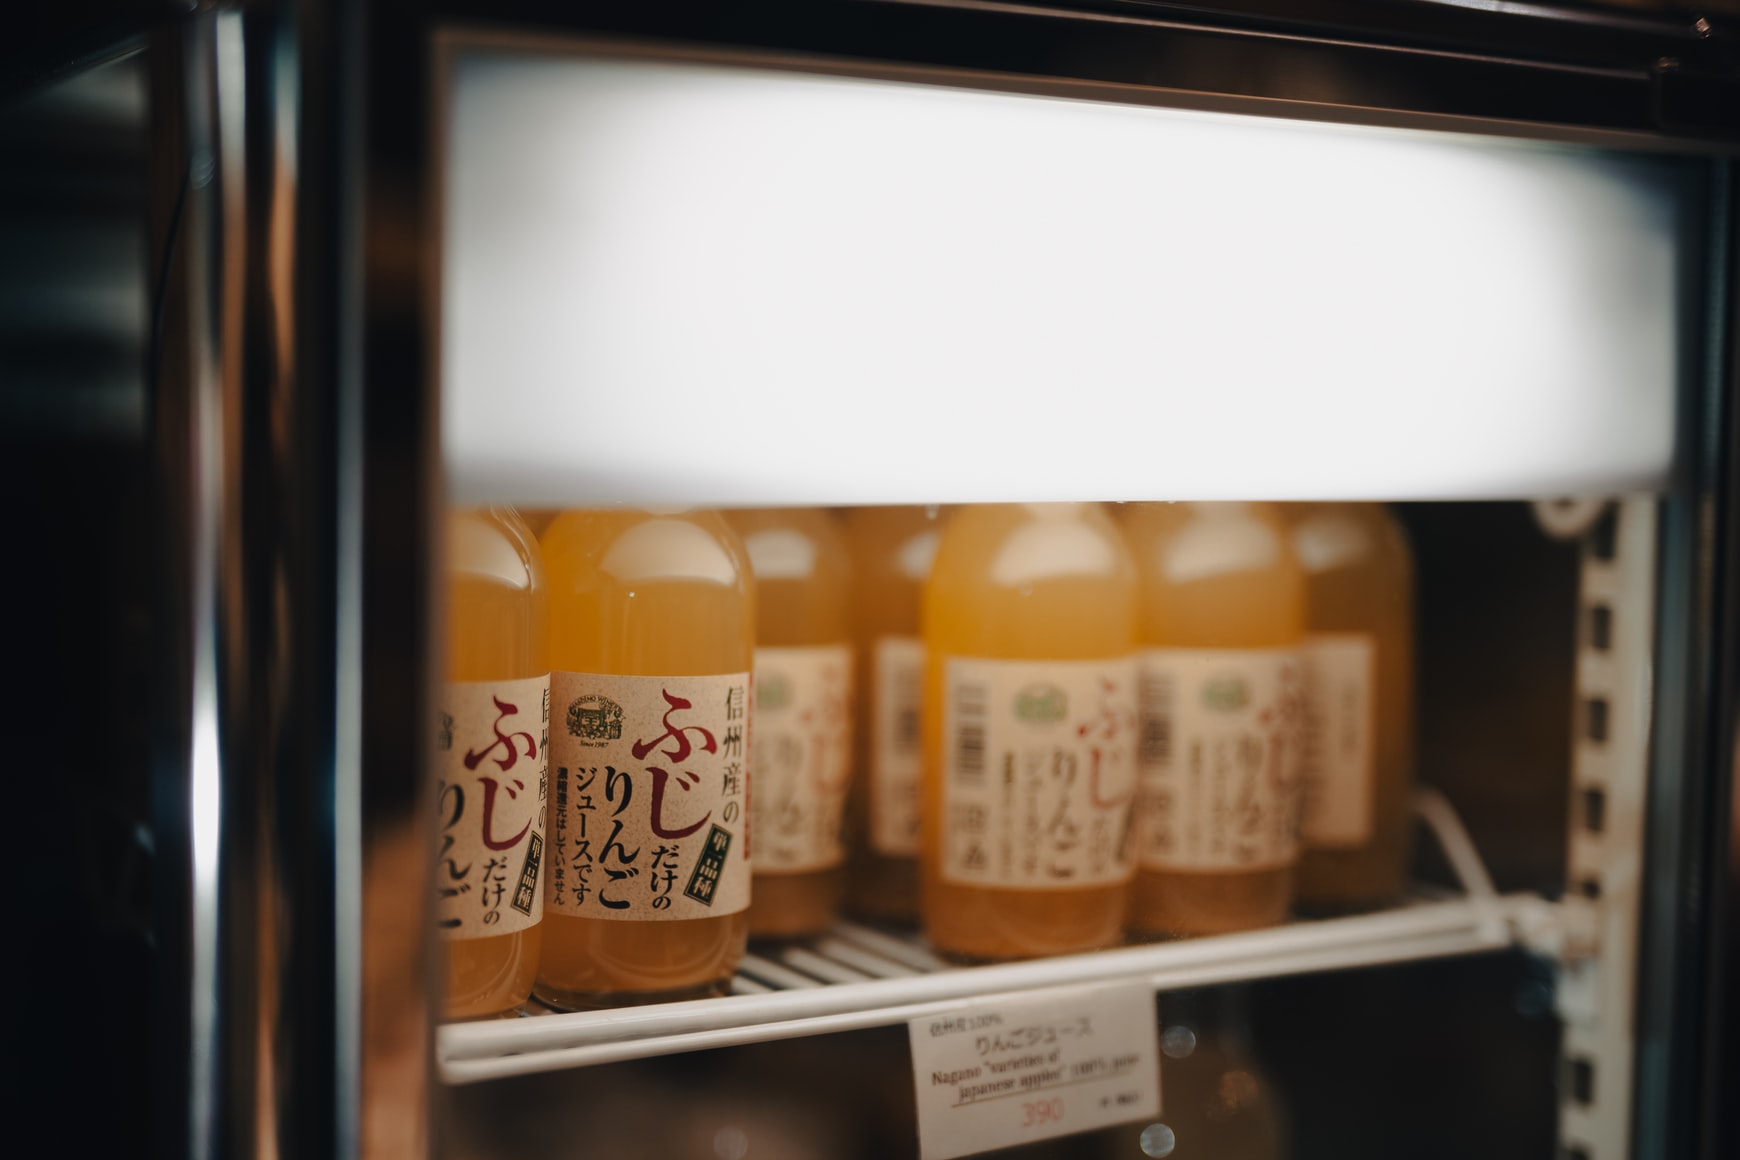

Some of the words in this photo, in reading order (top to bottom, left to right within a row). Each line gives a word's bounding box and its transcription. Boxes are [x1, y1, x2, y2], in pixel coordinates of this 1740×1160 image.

[463, 694, 537, 852] ふじ
[631, 687, 718, 840] ふじ
[721, 685, 745, 824] 信州産の
[481, 856, 507, 926] だけの
[571, 766, 598, 906] ジュースです
[598, 765, 641, 910] りんご
[651, 844, 680, 911] だけの
[931, 1067, 982, 1087] Nagano
[1021, 1095, 1065, 1128] 390
